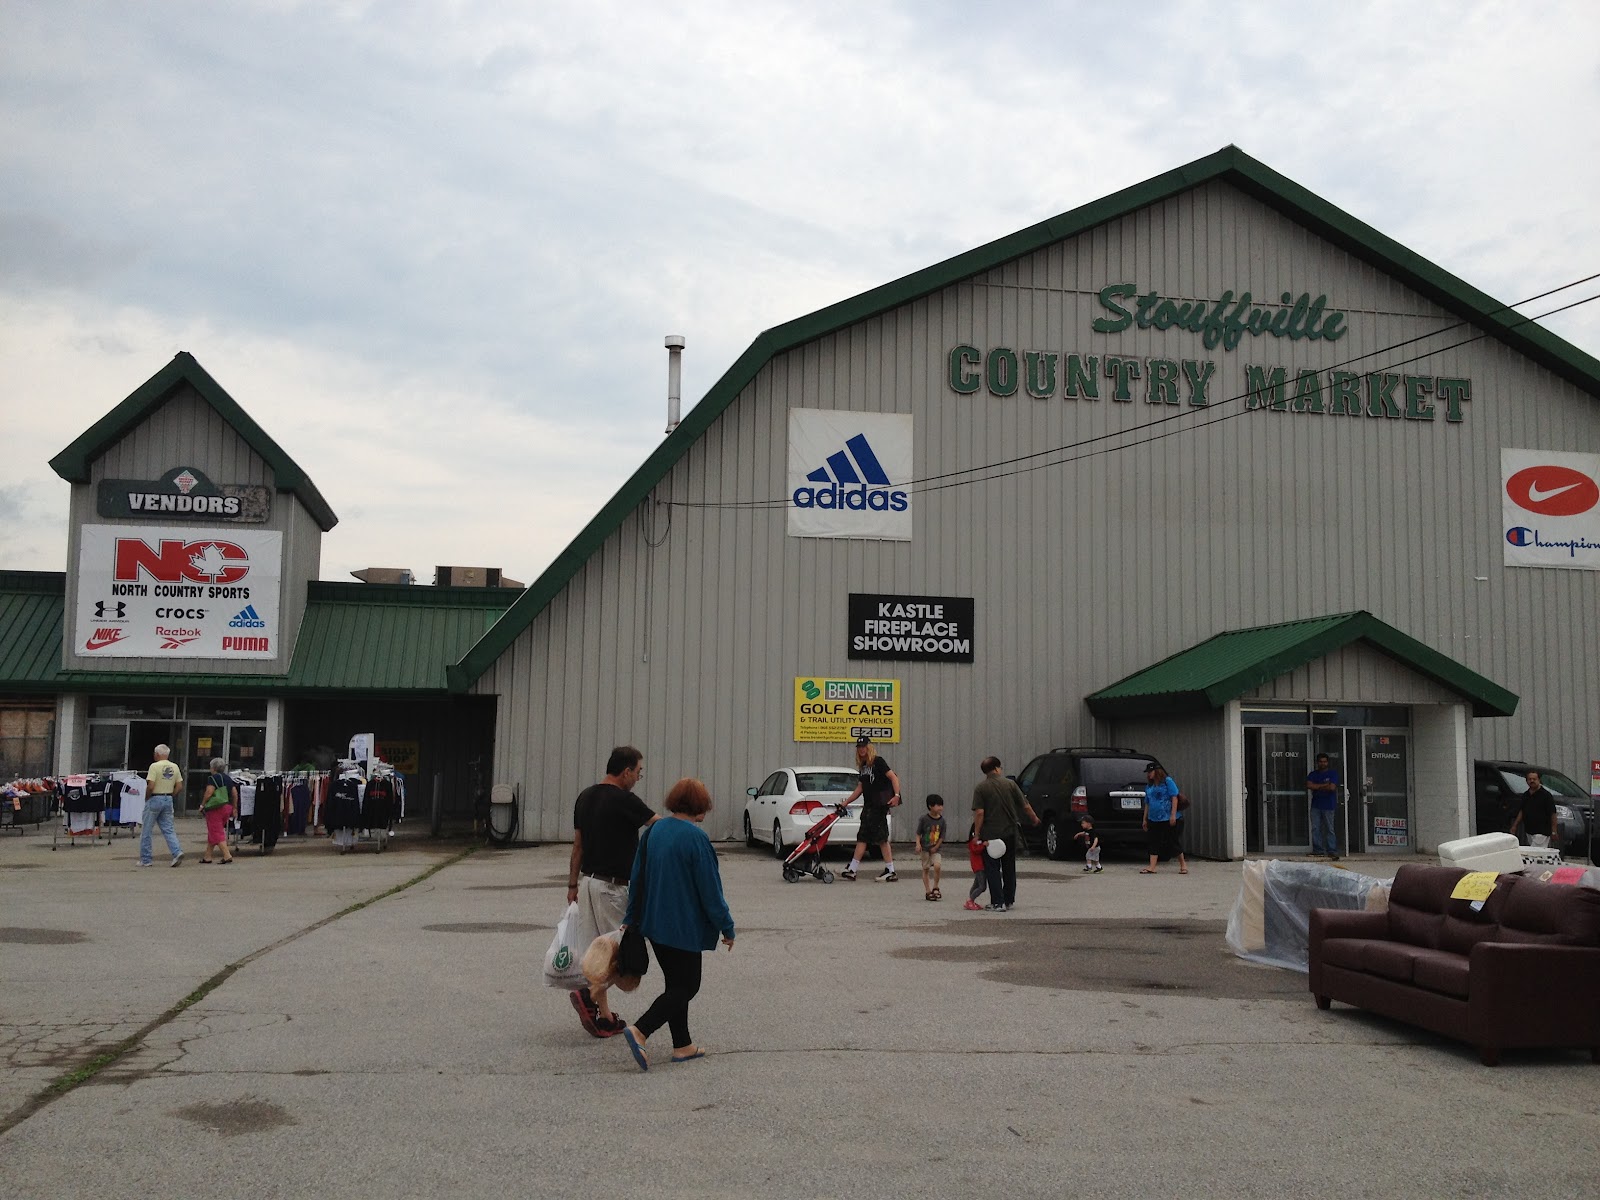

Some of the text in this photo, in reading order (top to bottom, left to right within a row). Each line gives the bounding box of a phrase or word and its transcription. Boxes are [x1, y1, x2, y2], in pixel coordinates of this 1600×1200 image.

[1092, 282, 1348, 351] Stouffville
[949, 344, 1473, 422] COUNTRY MARKET
[128, 492, 240, 515] VENDORS
[793, 482, 908, 512] adidas
[113, 537, 250, 585] NC
[112, 584, 250, 600] NORTH COUNTRY SPORTS
[155, 607, 205, 619] crocs
[879, 602, 944, 620] KASTLE
[156, 626, 202, 637] Reebok
[229, 619, 265, 628] adidas
[864, 619, 958, 637] FIREPLACE
[93, 628, 122, 641] NIKE
[222, 636, 269, 652] PUMA
[853, 635, 970, 654] SHOWROOM
[828, 682, 890, 700] BENNETT
[801, 703, 894, 716] GOLF CARS
